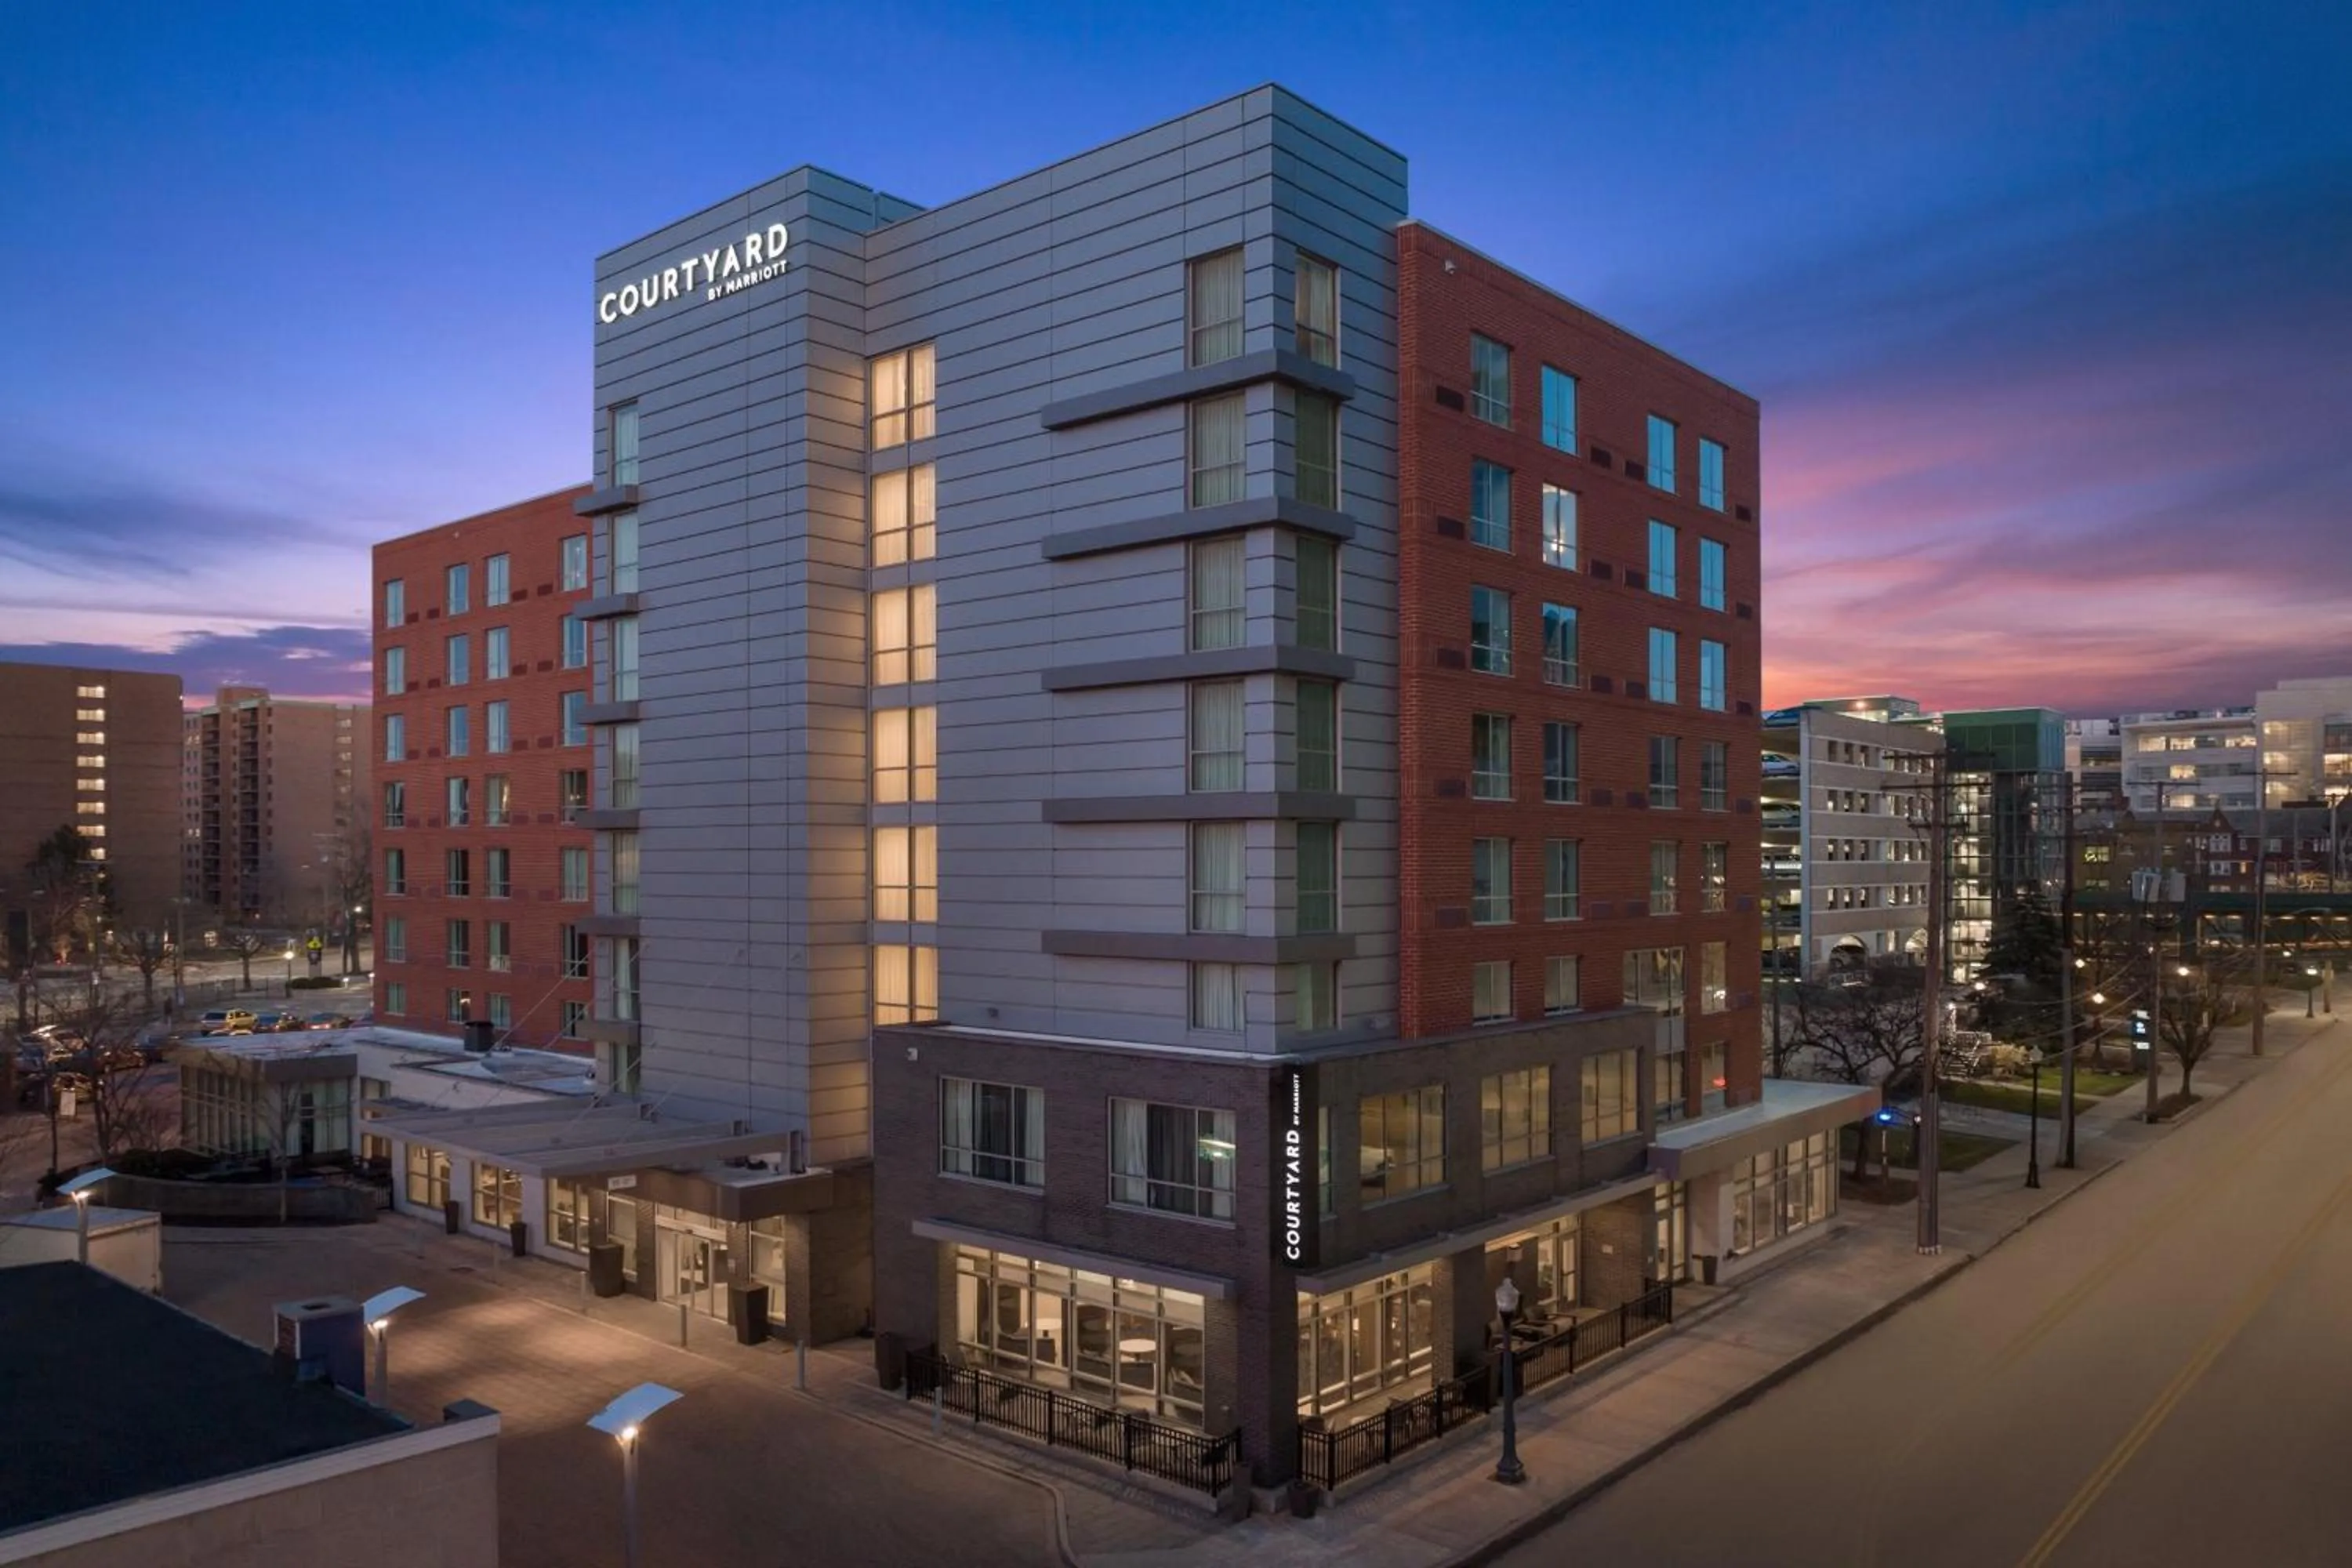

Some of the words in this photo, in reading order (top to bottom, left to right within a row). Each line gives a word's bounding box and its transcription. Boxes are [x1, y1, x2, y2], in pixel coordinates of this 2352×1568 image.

[600, 223, 787, 323] COURTYARD
[708, 285, 722, 301] BY
[726, 260, 787, 294] MARRIOTT
[1287, 1129, 1301, 1260] COURTYARD
